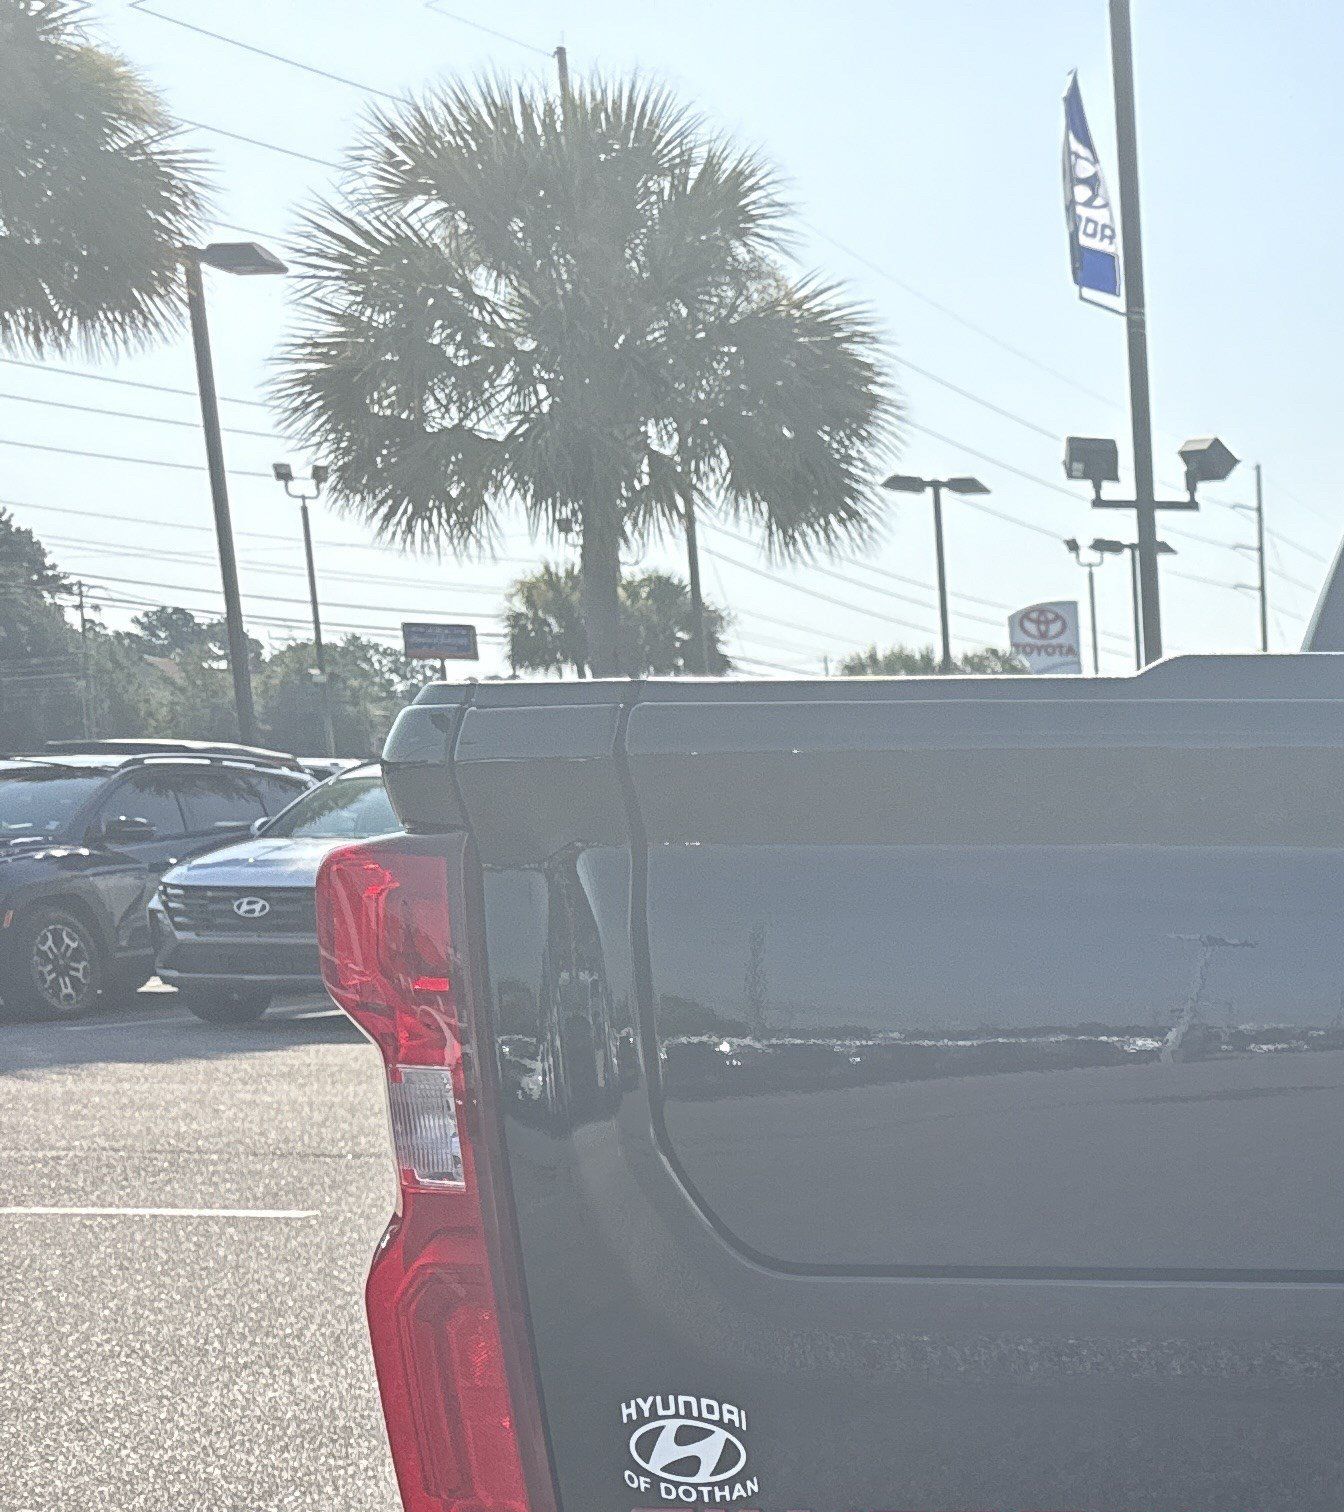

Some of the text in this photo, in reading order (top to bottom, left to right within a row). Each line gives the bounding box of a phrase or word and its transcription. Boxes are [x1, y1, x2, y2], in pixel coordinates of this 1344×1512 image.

[620, 1394, 747, 1431] HYUNDAI
[623, 1469, 760, 1503] OF DOTHAN
